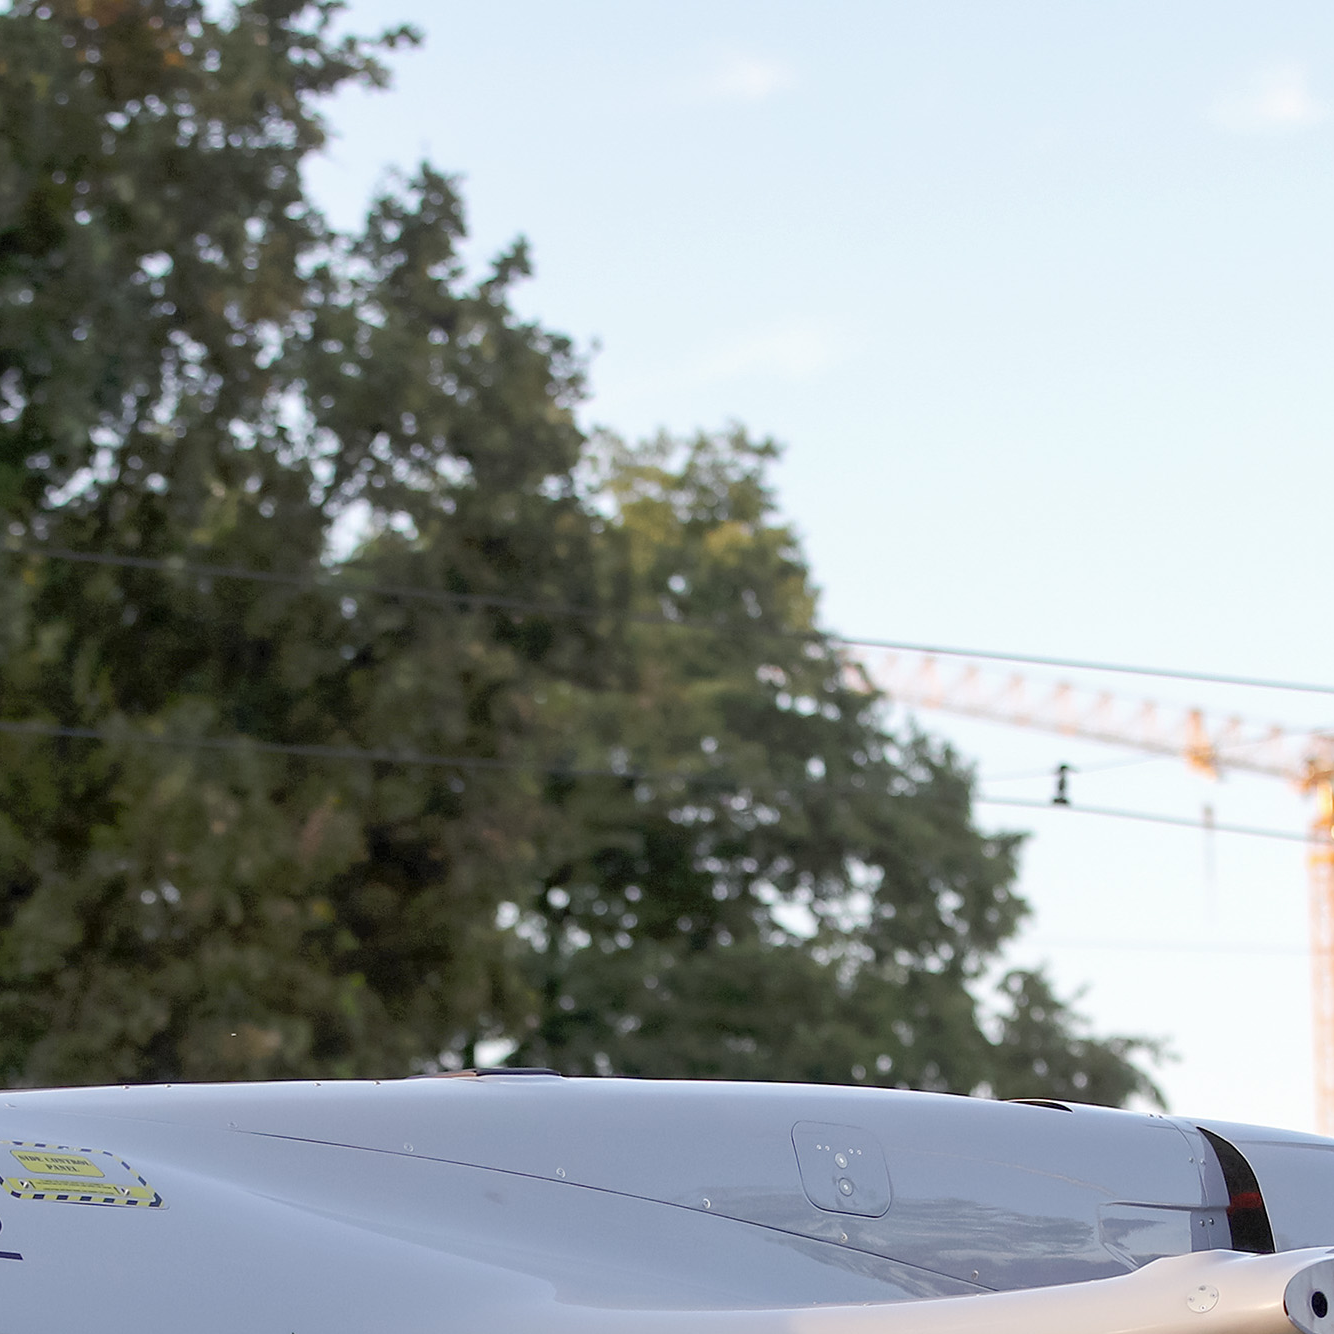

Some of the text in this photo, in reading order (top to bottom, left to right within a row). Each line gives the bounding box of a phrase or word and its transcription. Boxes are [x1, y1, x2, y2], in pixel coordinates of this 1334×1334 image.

[17, 1155, 93, 1167] SIDE CONTROL
[45, 1163, 80, 1172] PANEL
